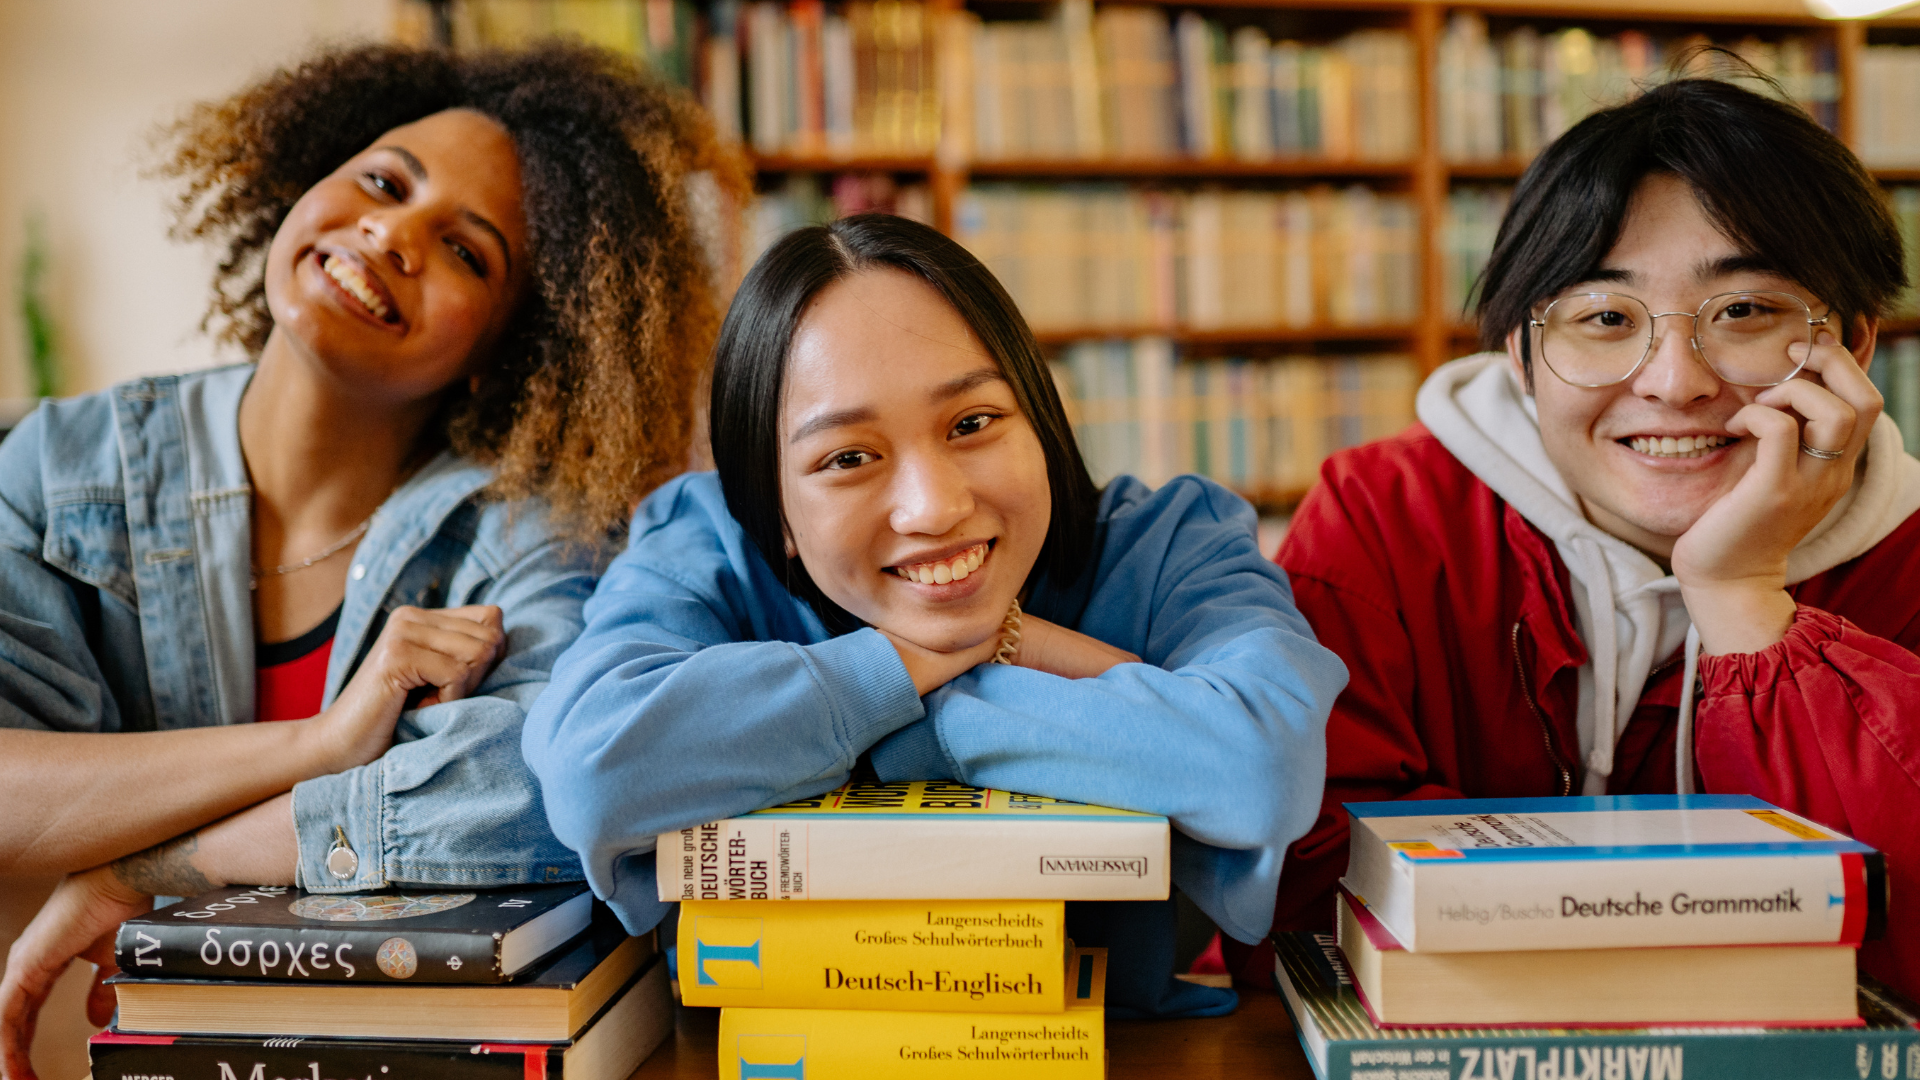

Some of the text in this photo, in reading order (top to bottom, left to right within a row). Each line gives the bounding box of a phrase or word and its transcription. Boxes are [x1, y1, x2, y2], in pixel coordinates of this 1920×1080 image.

[683, 855, 694, 880] neue
[701, 823, 719, 900] DEUTSCHE
[724, 831, 747, 900] WÖRTER-
[778, 829, 791, 893] FREMDWÖRTER-
[681, 883, 694, 900] Das
[750, 861, 768, 900] BUCH
[793, 872, 803, 893] BUCH
[1560, 888, 1804, 919] Deutsche Grammatik
[926, 911, 1044, 931] Langenscheidts
[134, 930, 163, 967] IV
[854, 930, 1044, 949] Großes Schulwörterbuch
[823, 967, 1044, 1001] Deutsch-Englisch
[970, 1025, 1090, 1043] Langenscheidts
[899, 1045, 1090, 1062] Großes Schulwörterbuch
[1458, 1045, 1684, 1080] MARKTPLATZ
